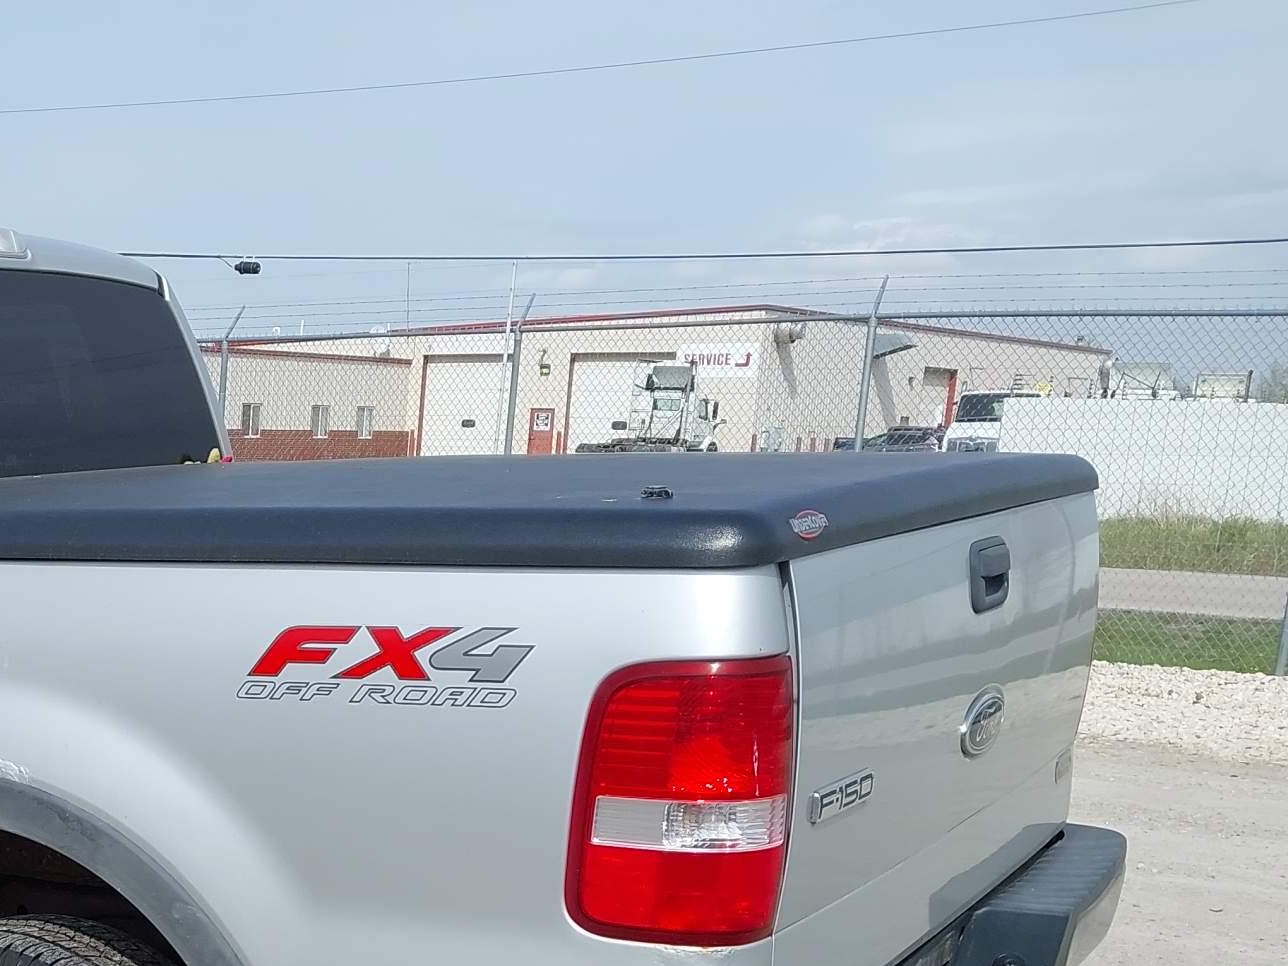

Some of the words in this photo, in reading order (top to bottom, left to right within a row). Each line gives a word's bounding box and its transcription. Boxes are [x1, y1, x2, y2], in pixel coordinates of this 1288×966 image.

[683, 352, 732, 367] SERVICE
[245, 624, 537, 684] FX4
[235, 680, 341, 702] OFF
[348, 683, 518, 708] ROAD
